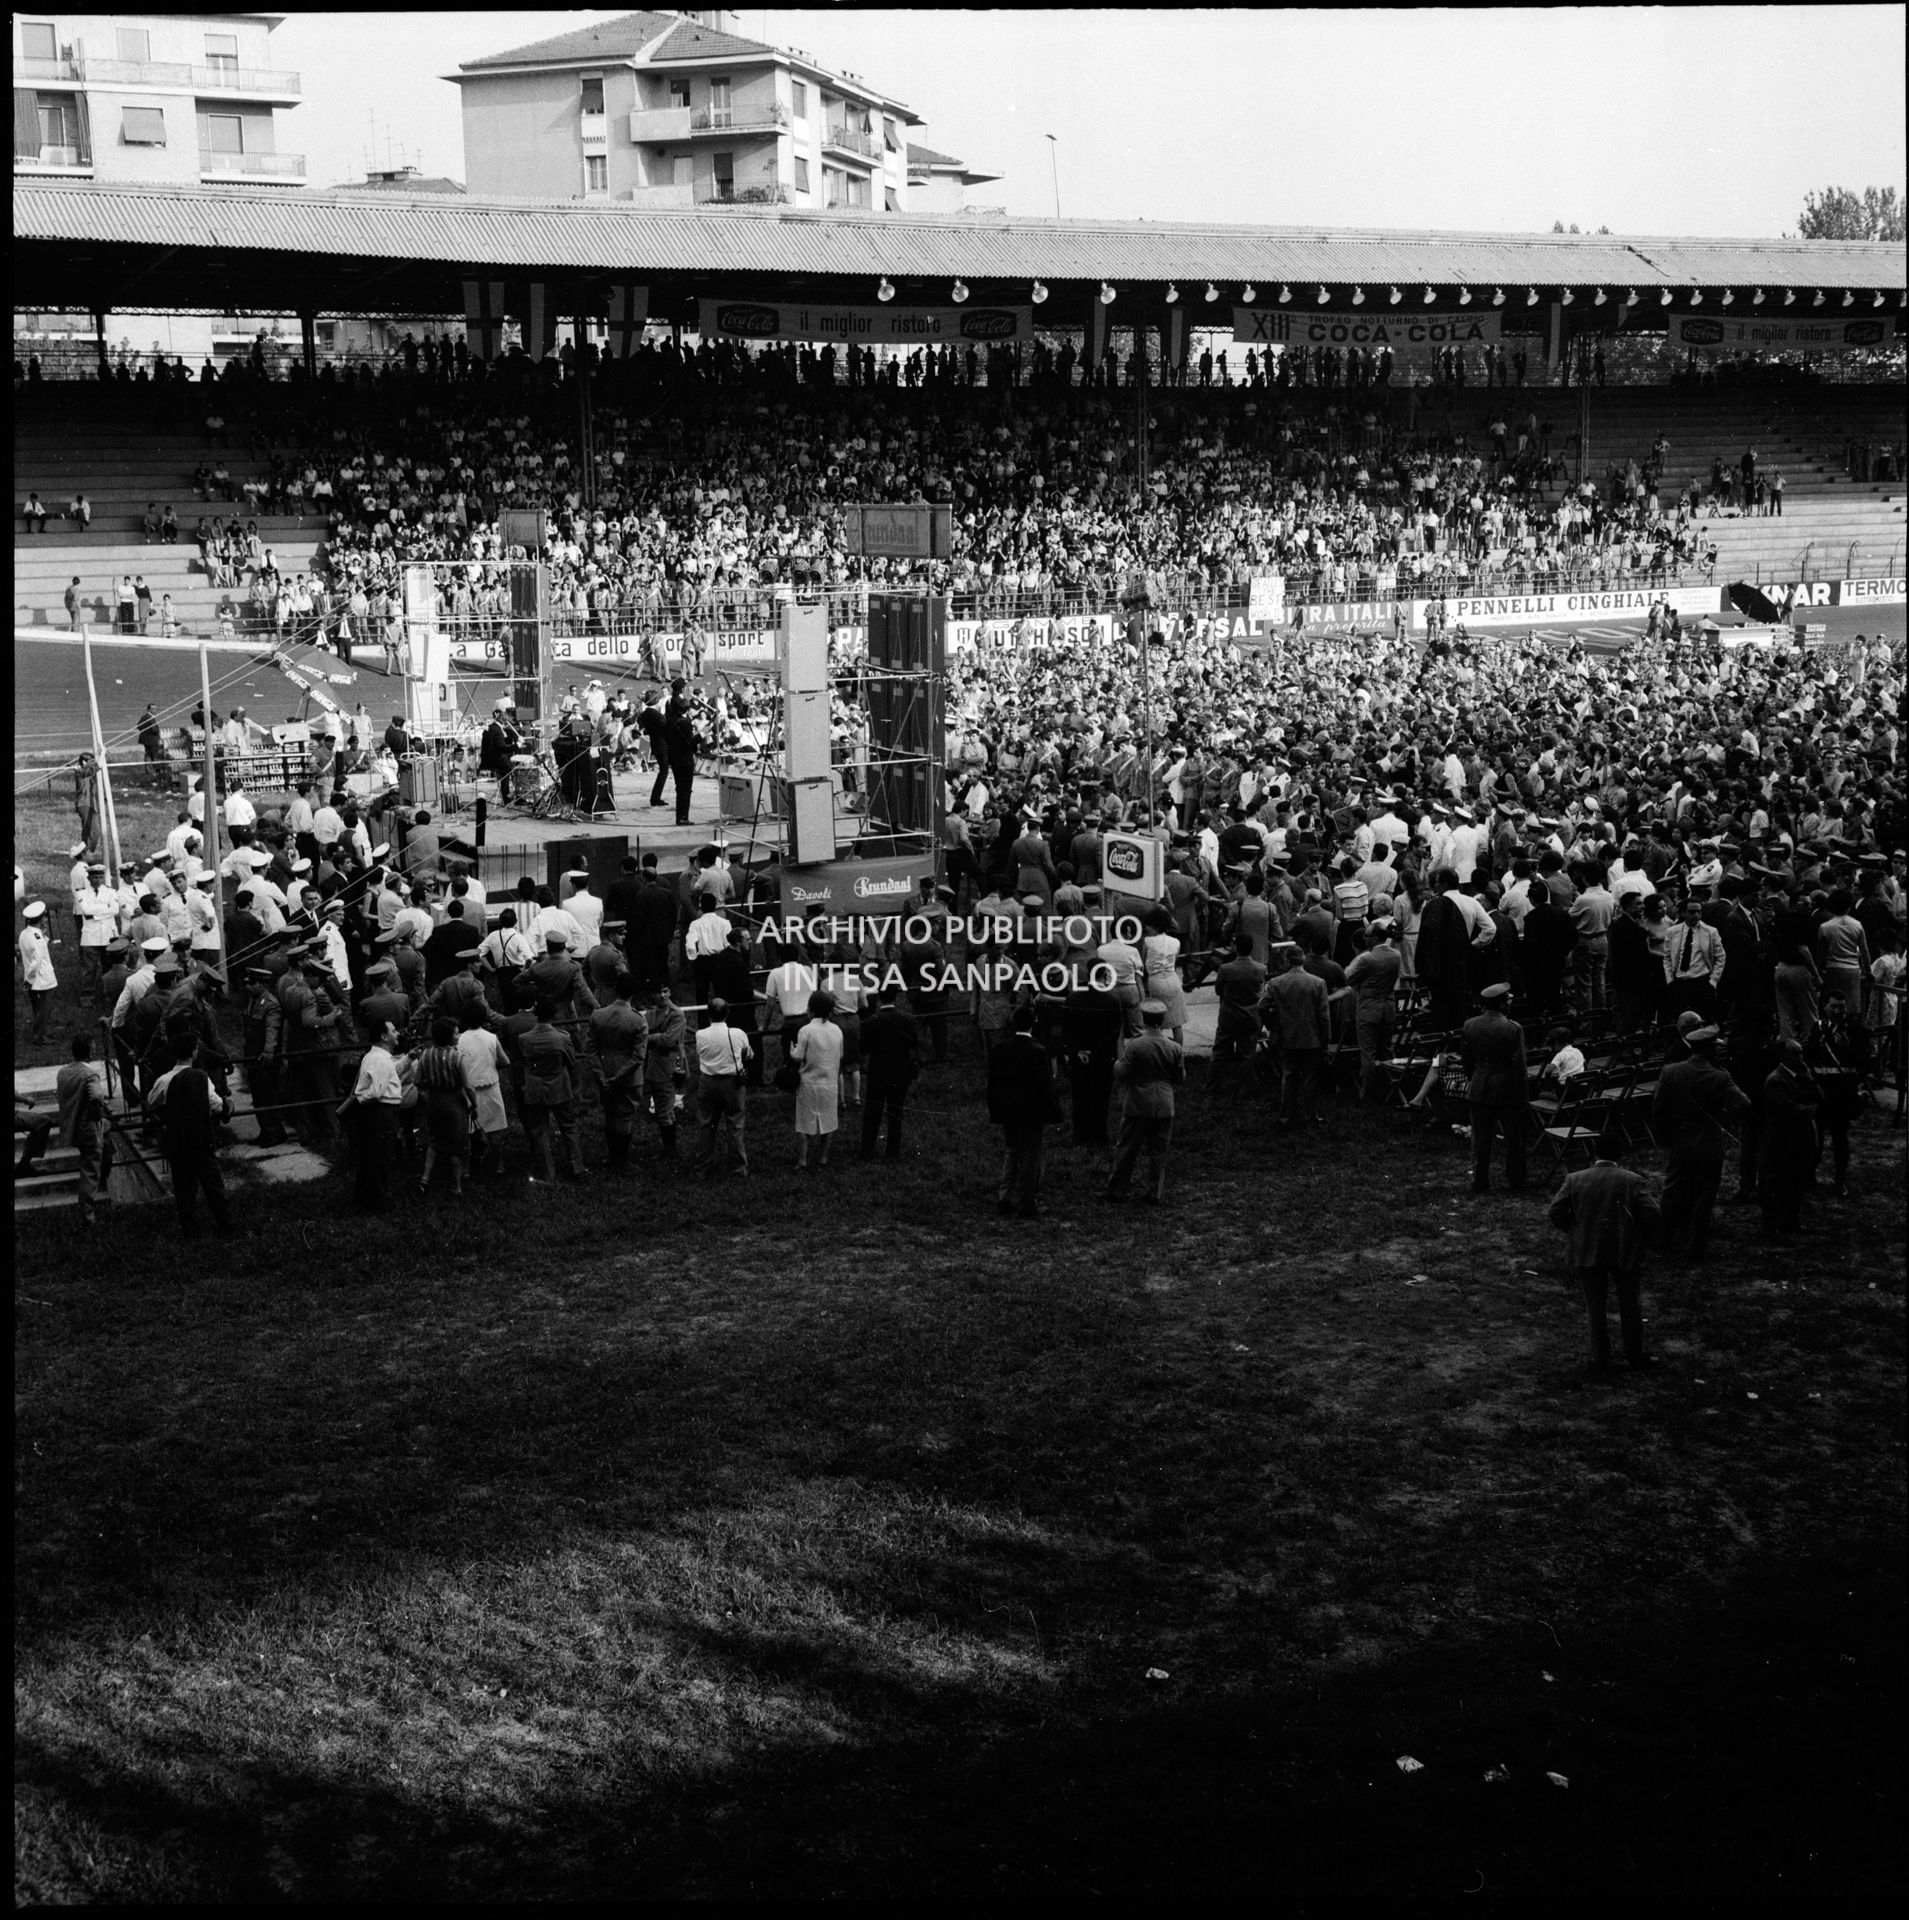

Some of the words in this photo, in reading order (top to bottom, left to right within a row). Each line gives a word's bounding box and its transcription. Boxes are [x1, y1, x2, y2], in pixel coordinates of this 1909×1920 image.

[800, 310, 809, 331] il
[820, 312, 872, 338] miglior
[891, 314, 941, 334] ristoro
[1309, 315, 1350, 324] TROFEO
[1360, 315, 1419, 325] NOTTURNO
[1427, 316, 1439, 325] DI
[1447, 315, 1485, 325] CALCIO
[1307, 323, 1484, 343] COCA-COLA
[1738, 322, 1745, 340] il
[1752, 324, 1788, 345] miglior
[1796, 323, 1831, 341] ristoro
[1844, 579, 1907, 597] TERMO
[1250, 593, 1282, 606] BEST
[1457, 596, 1555, 617] PENNELLI
[1567, 591, 1669, 611] CINGHIALE
[587, 635, 629, 656] dello
[718, 630, 764, 650] sport
